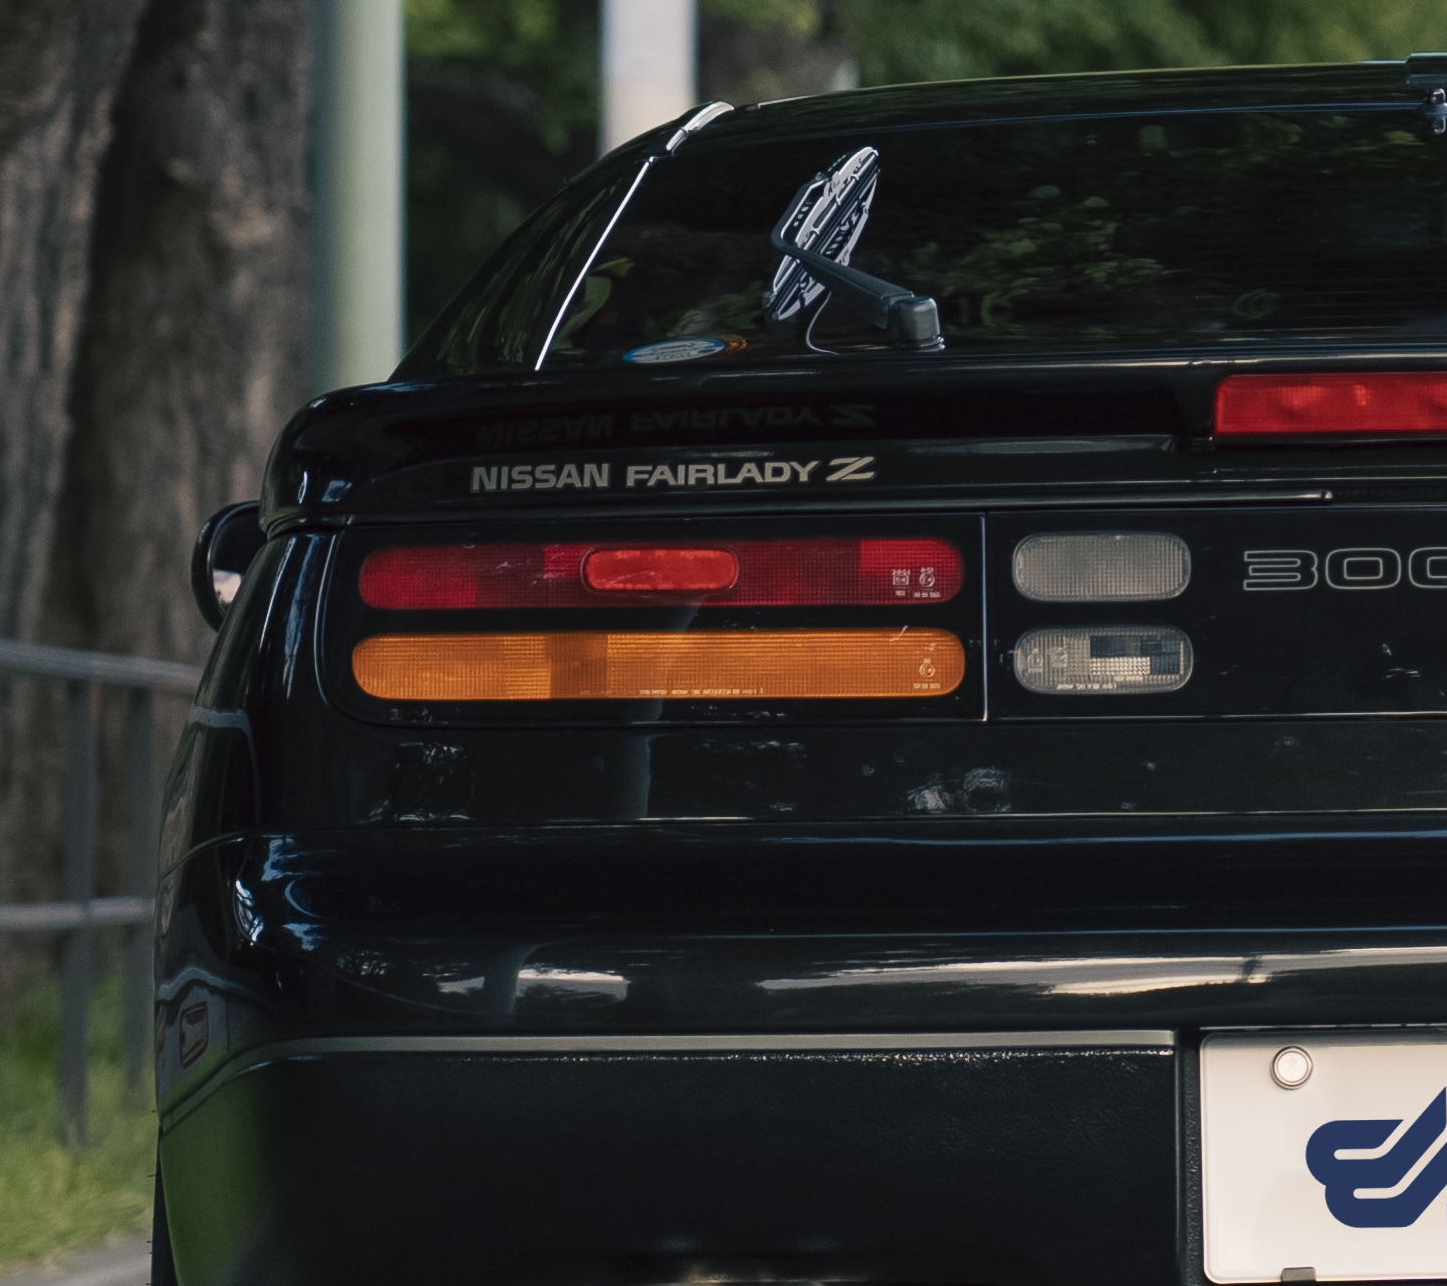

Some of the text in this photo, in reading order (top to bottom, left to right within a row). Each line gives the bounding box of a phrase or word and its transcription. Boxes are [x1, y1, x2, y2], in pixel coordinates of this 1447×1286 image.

[471, 456, 877, 492] NISSAN FAIRLADY Z
